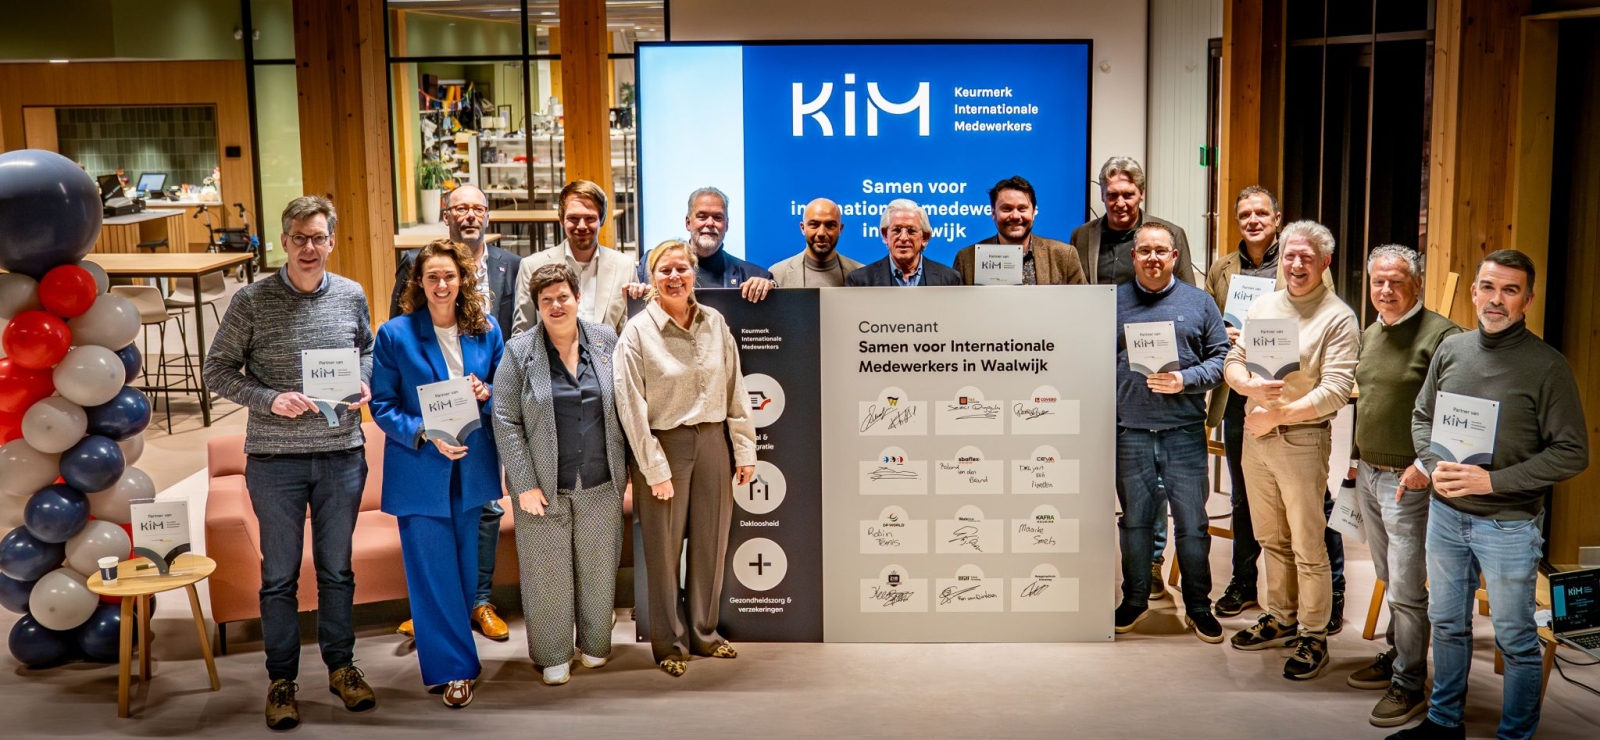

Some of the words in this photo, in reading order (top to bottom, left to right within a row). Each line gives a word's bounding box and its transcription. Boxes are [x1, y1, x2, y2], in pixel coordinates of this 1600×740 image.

[954, 86, 1013, 98] Keurmerk
[792, 73, 931, 137] KiM
[954, 103, 1039, 115] Internationale
[954, 120, 1032, 132] Medewerkers
[862, 179, 923, 194] Samen
[928, 182, 967, 194] voor
[862, 223, 879, 238] in
[858, 320, 939, 333] Convenant
[858, 340, 909, 353] Samen
[913, 342, 947, 353] voor
[951, 339, 1055, 352] Internationale
[858, 360, 958, 373] Medewerkers
[963, 359, 976, 372] in
[980, 359, 1048, 374] Waalwijk
[729, 596, 785, 605] Gezondheidszorg
[738, 606, 784, 614] verzekeringen
